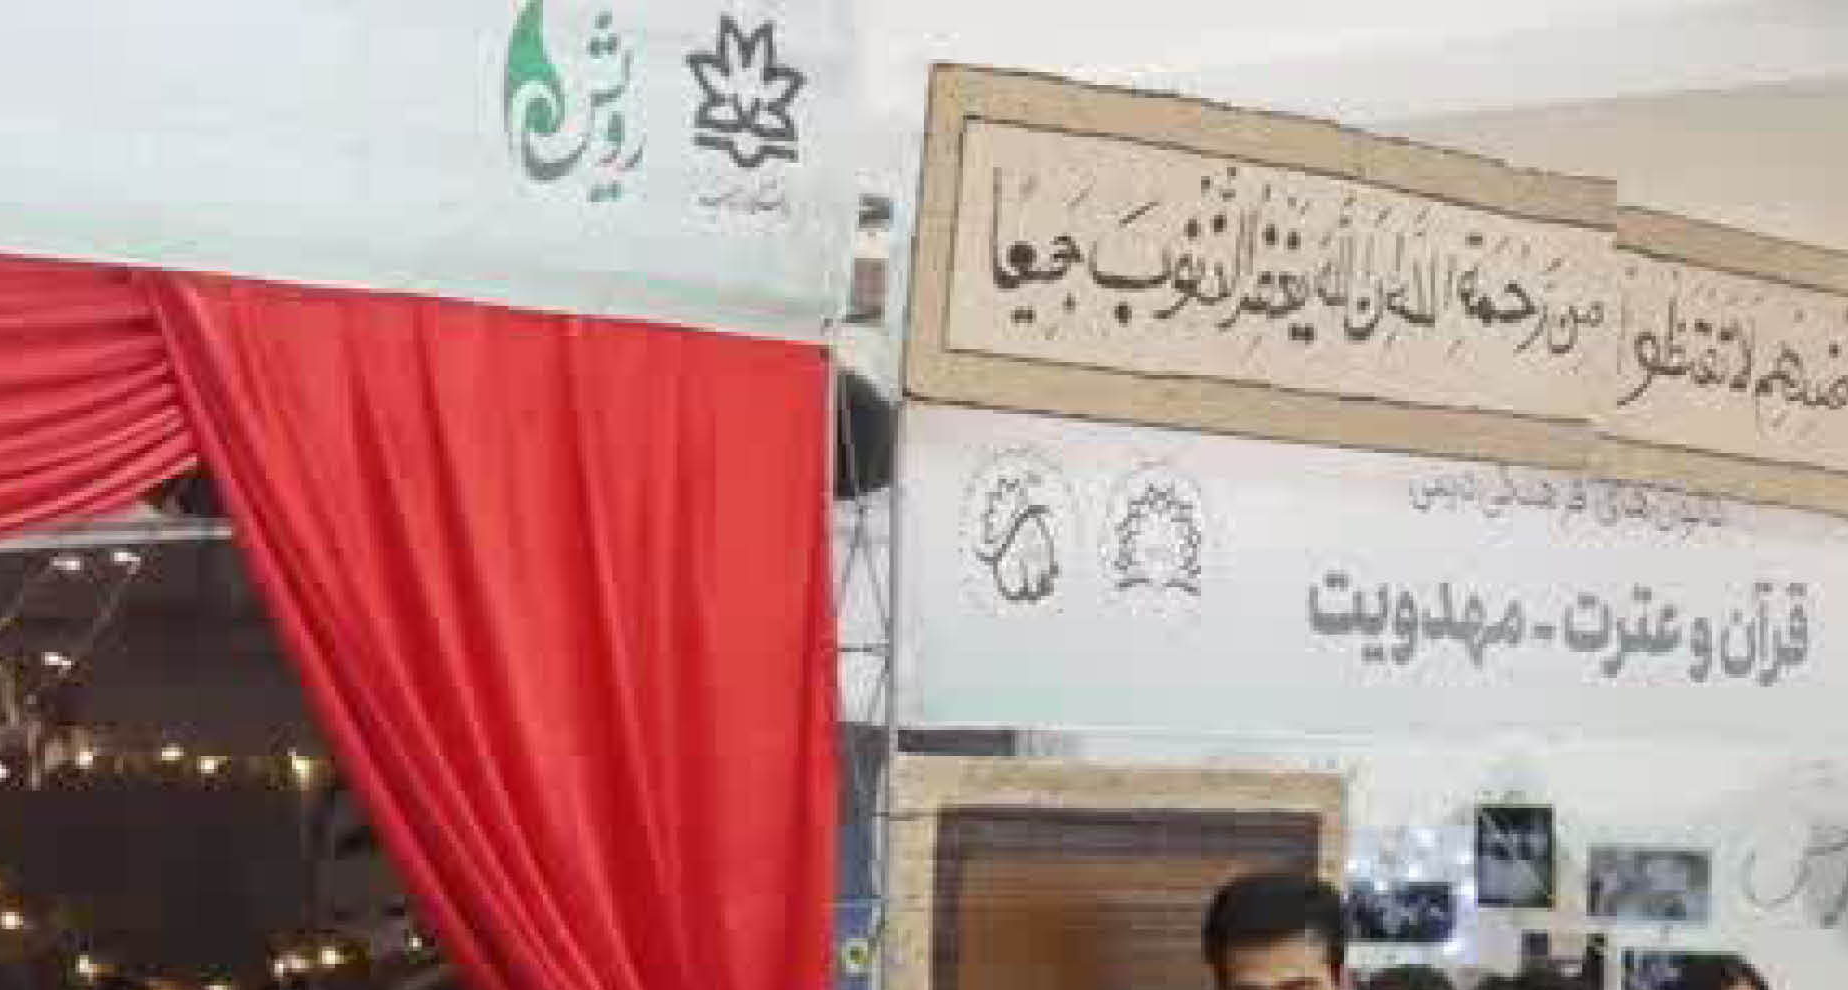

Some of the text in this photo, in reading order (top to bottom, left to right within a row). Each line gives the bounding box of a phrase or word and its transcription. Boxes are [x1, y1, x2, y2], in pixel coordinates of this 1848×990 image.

[1307, 569, 1524, 670] مهدویت
[1563, 582, 1680, 679] عترت
[1689, 616, 1713, 683] و
[1721, 581, 1809, 687] قرآن
